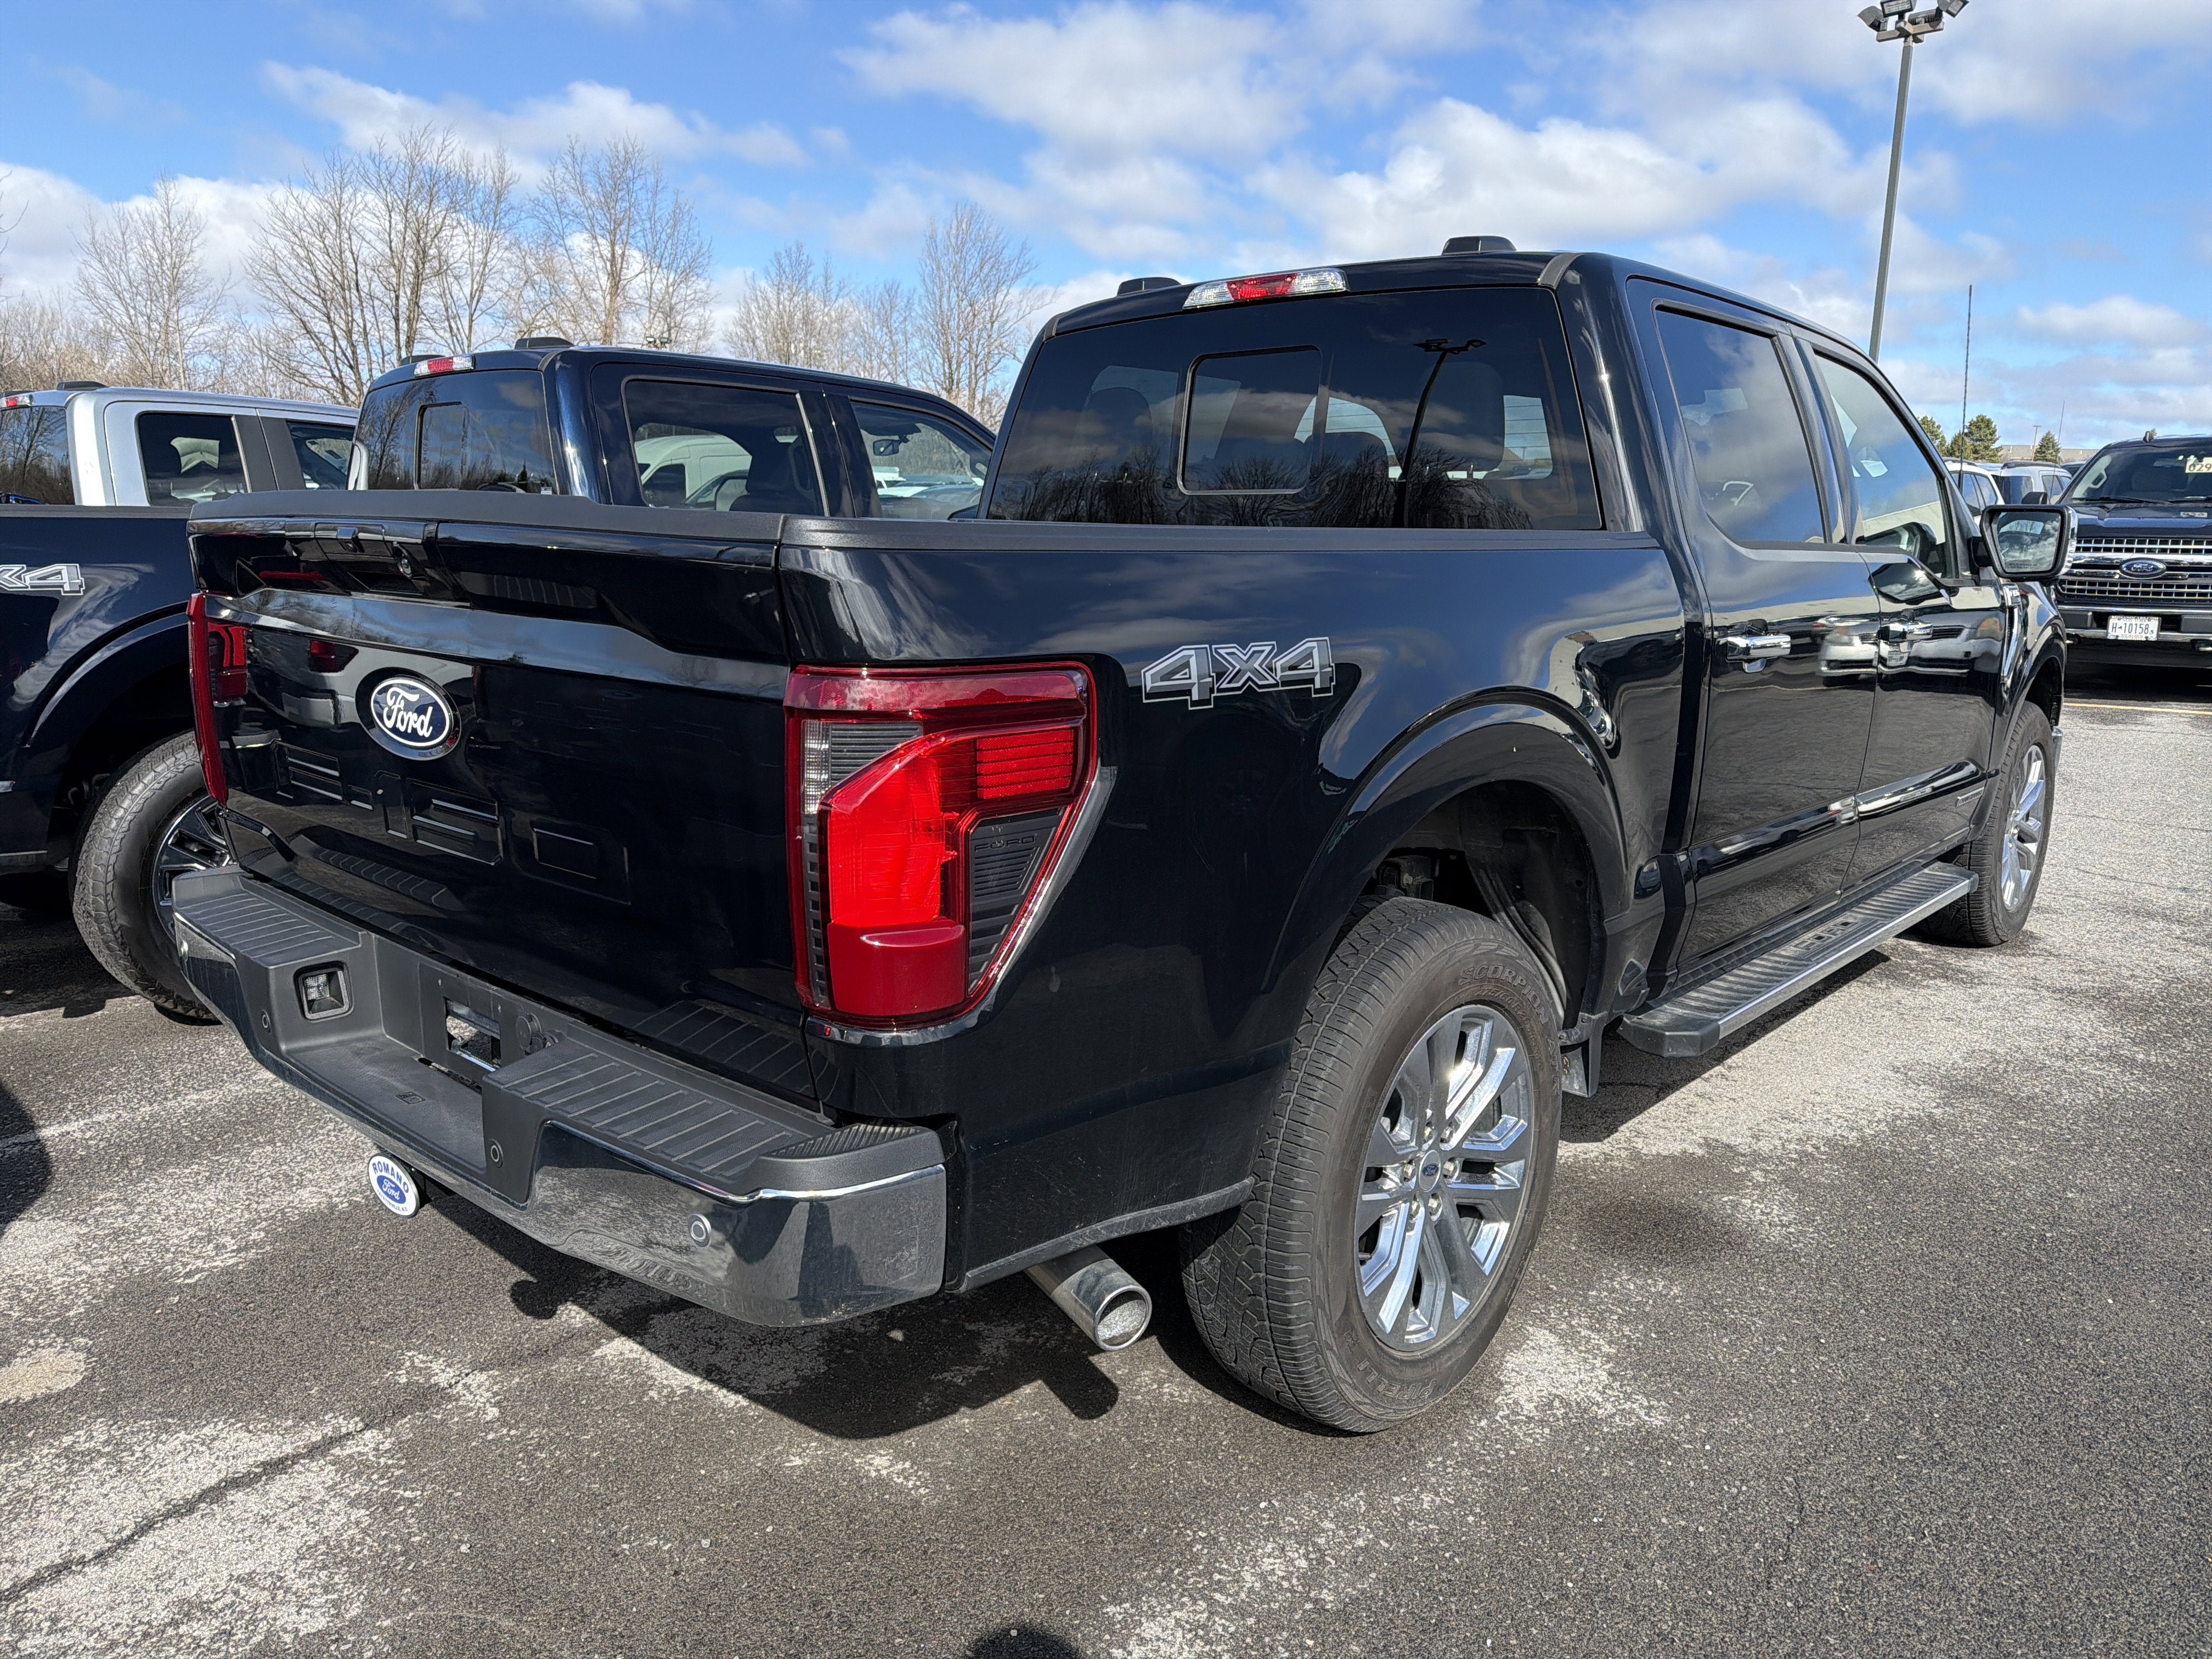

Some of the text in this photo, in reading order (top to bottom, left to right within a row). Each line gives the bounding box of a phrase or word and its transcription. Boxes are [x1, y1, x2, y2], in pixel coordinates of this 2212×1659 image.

[1141, 637, 1335, 710] 4X4
[383, 687, 433, 737] Ford
[274, 738, 632, 906] F-150
[974, 836, 1035, 852] FORD
[1792, 920, 1860, 951] FORD
[1459, 964, 1549, 1025] SCORPION
[372, 1161, 409, 1193] ROMANO
[1425, 1165, 1437, 1175] Ford
[382, 1178, 400, 1200] Ford
[1357, 1359, 1437, 1400] PIRELLI
